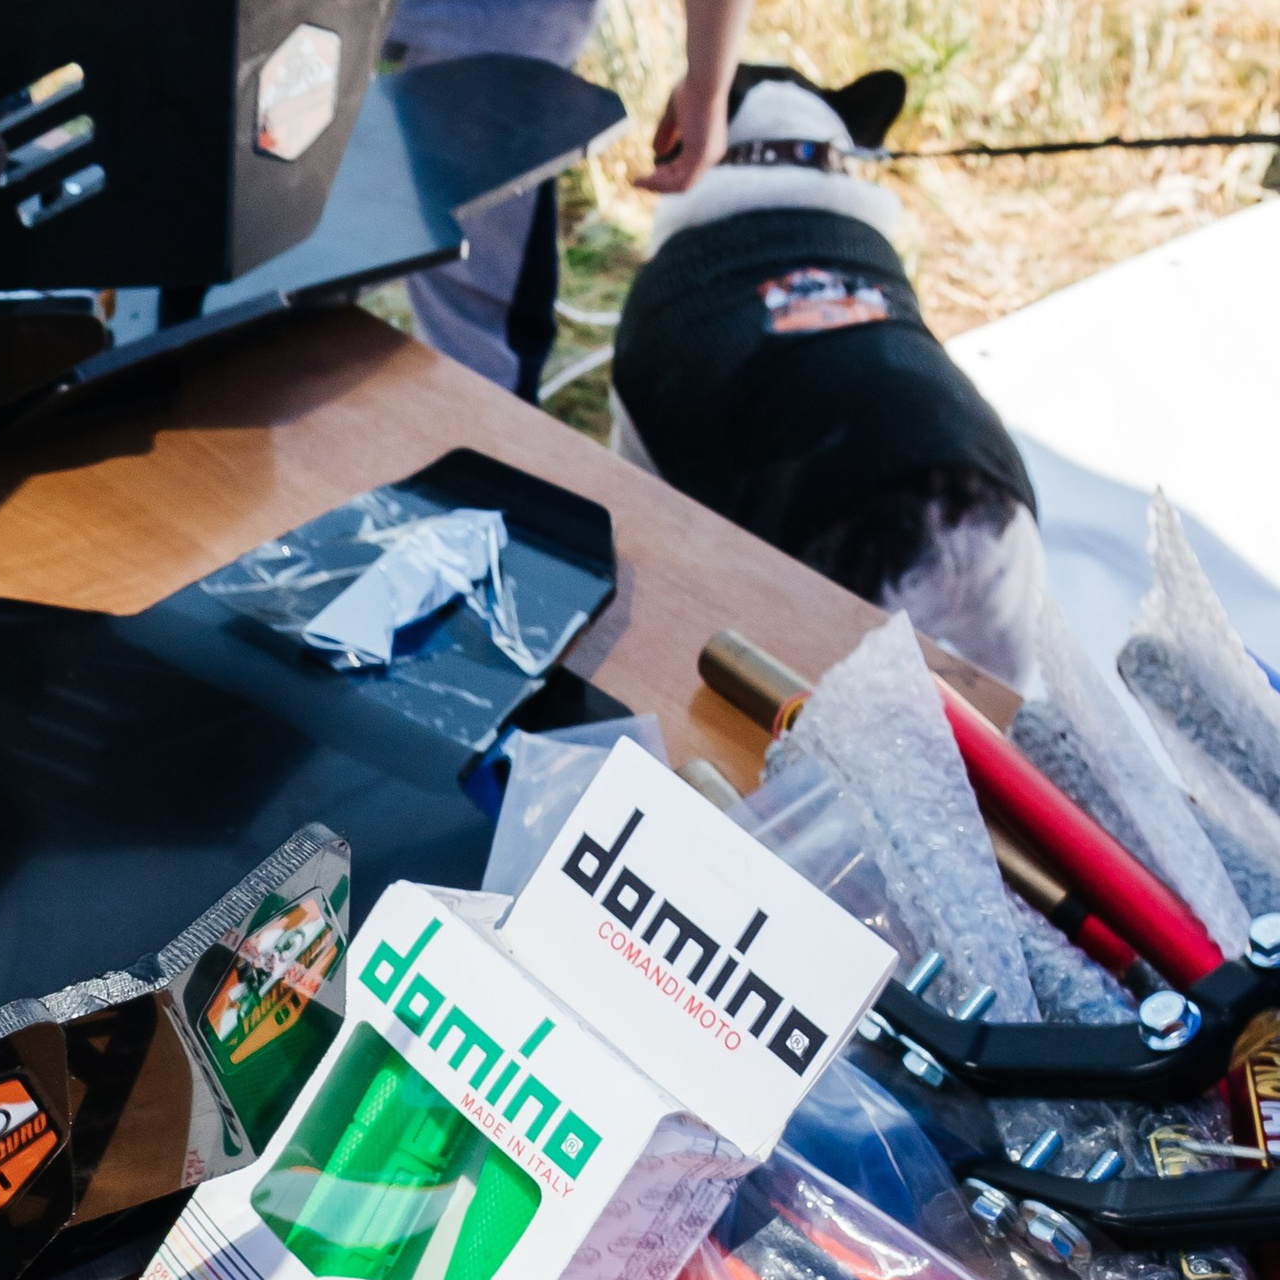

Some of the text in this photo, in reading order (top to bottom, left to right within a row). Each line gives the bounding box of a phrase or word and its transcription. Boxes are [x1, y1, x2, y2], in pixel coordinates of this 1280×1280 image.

[561, 806, 829, 1078] domino
[598, 921, 742, 1051] COMANDI MOTO
[358, 917, 604, 1181] domino
[460, 1092, 575, 1198] MADE IN ITALY
